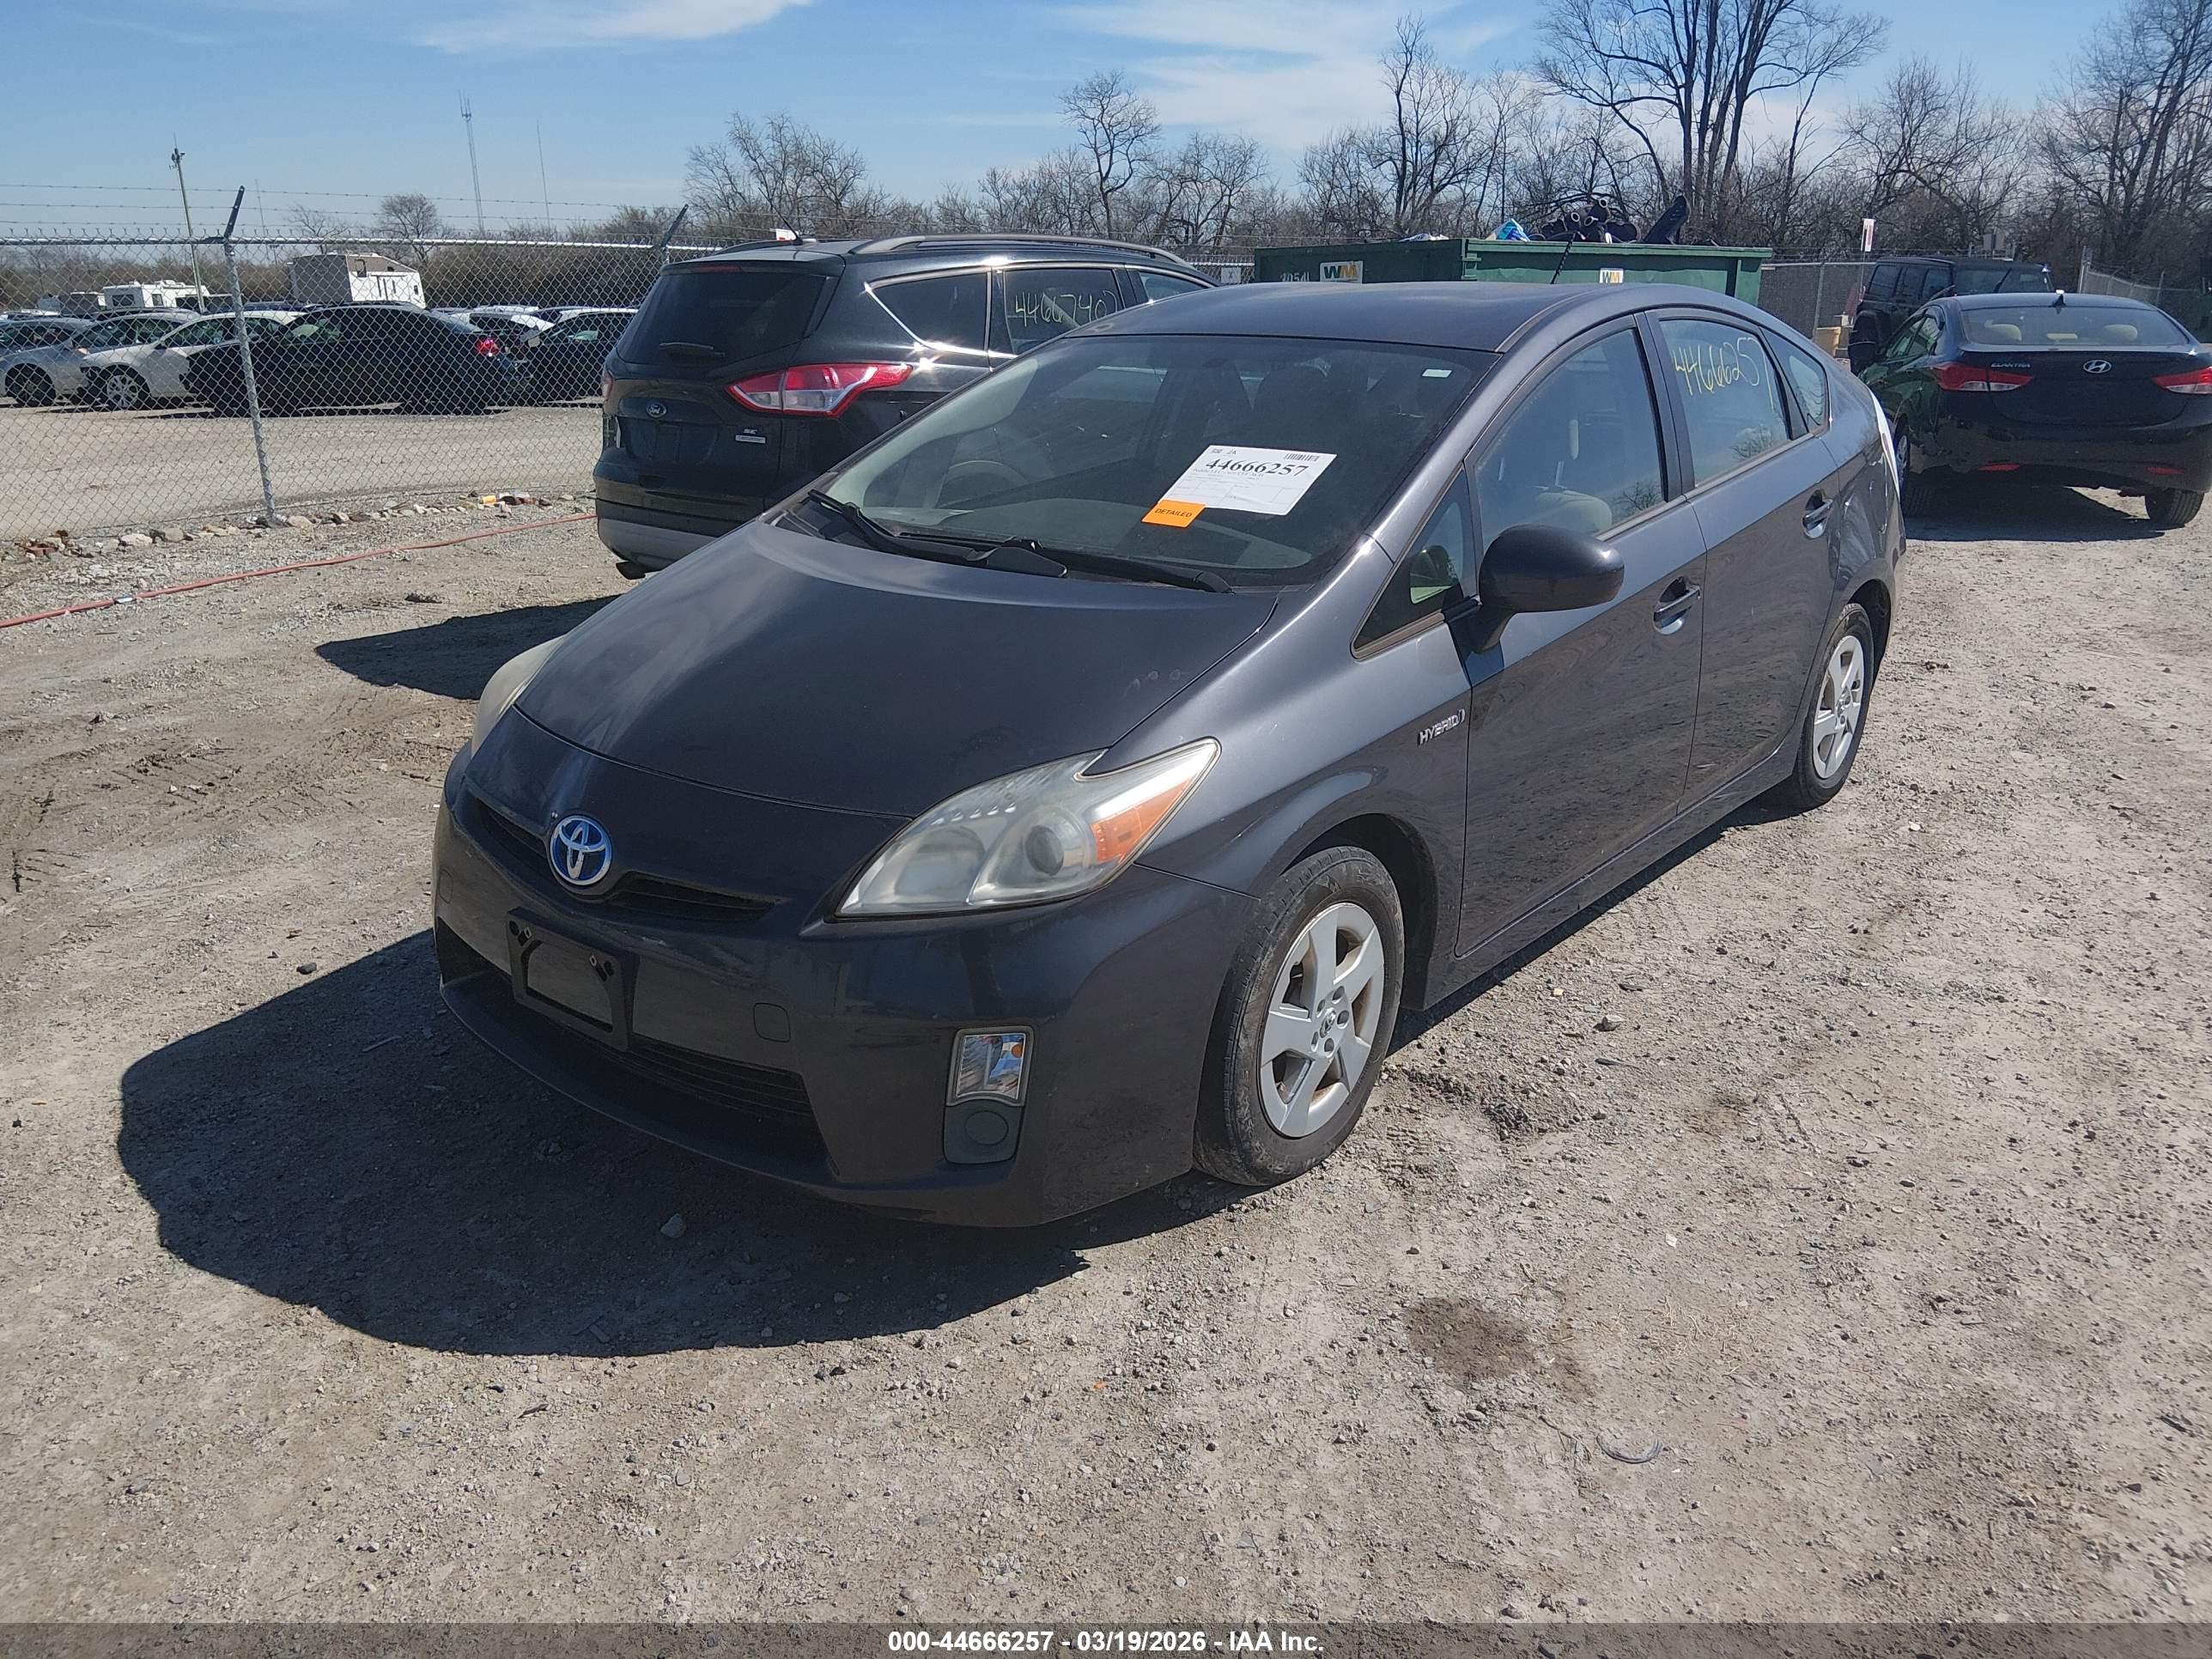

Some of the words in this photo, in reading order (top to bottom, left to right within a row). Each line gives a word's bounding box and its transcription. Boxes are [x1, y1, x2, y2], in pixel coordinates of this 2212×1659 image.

[1323, 264, 1357, 279] WM
[1672, 336, 1775, 413] 44666257
[1205, 458, 1309, 477] 44666257
[1154, 507, 1193, 519] DETAILED
[1419, 714, 1461, 745] HYBRID
